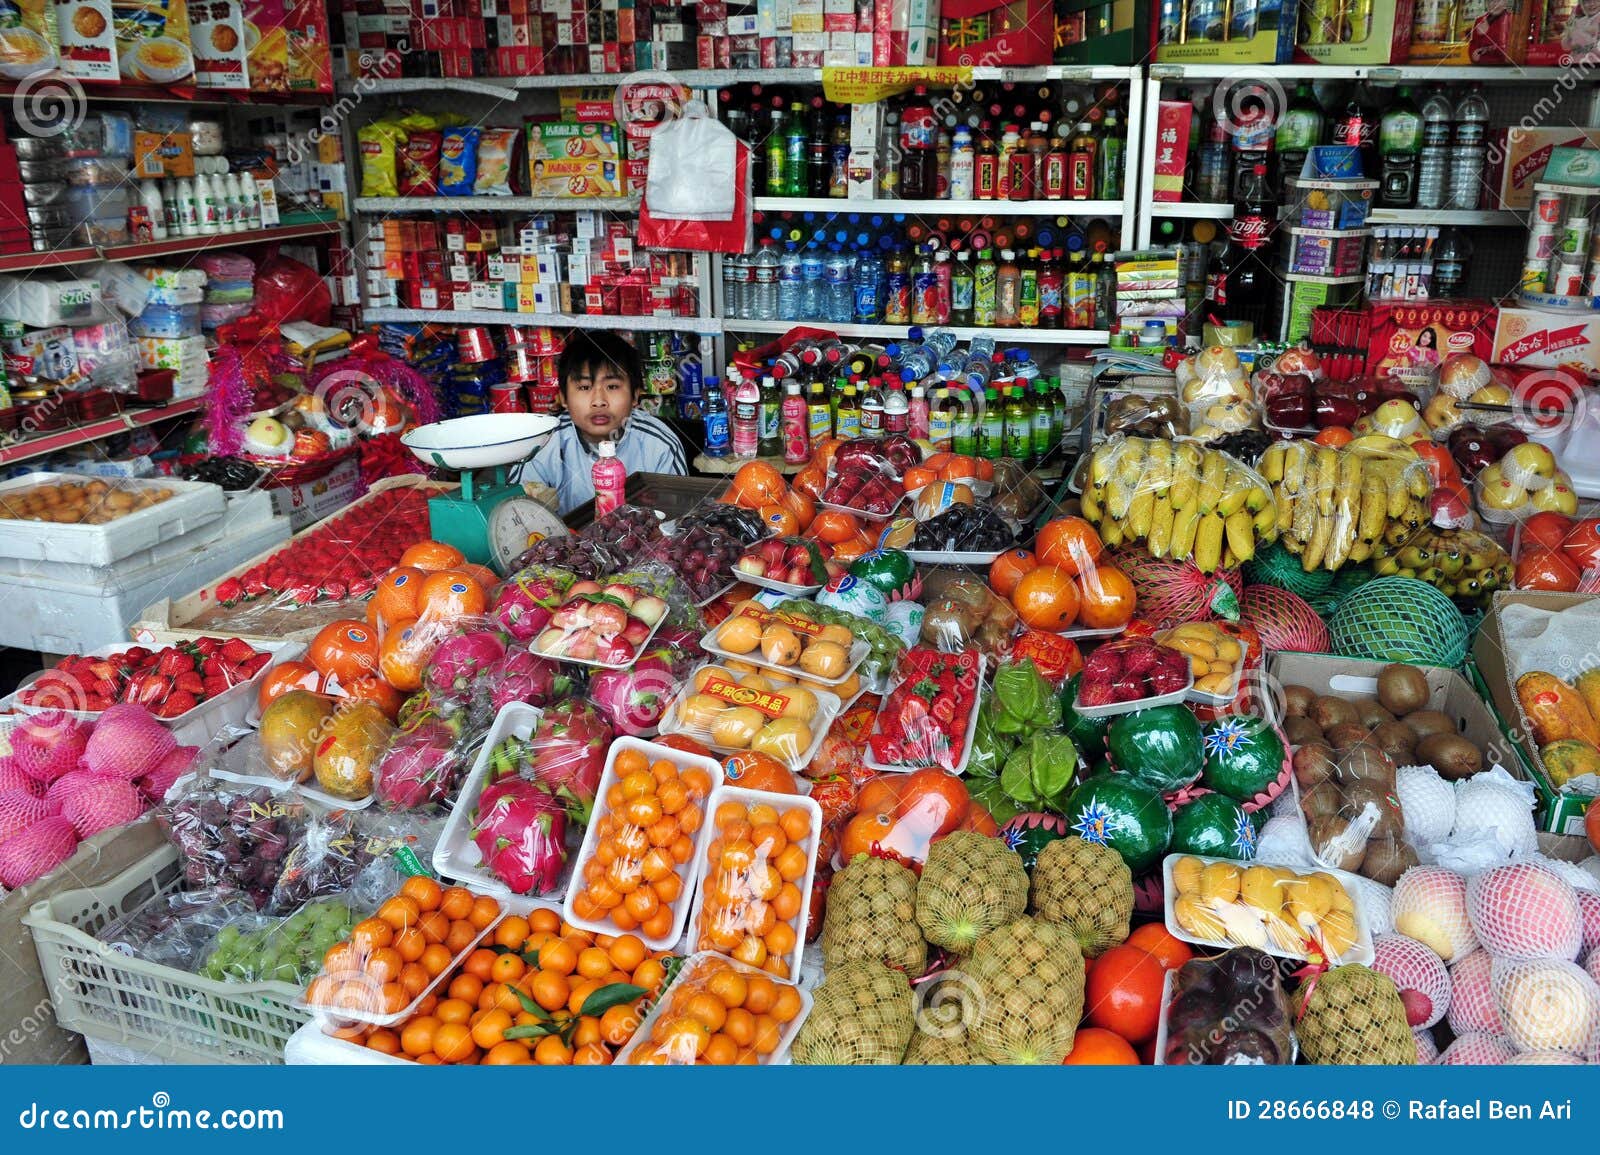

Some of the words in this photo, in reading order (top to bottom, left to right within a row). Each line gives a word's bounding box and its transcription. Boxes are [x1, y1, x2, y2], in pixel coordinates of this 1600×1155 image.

[833, 70, 959, 84] 江中集团专为病人设计
[1160, 128, 1178, 164] 福星
[1502, 333, 1544, 365] 娃哈哈
[502, 546, 510, 556] 8
[711, 682, 784, 713] 华阳果品
